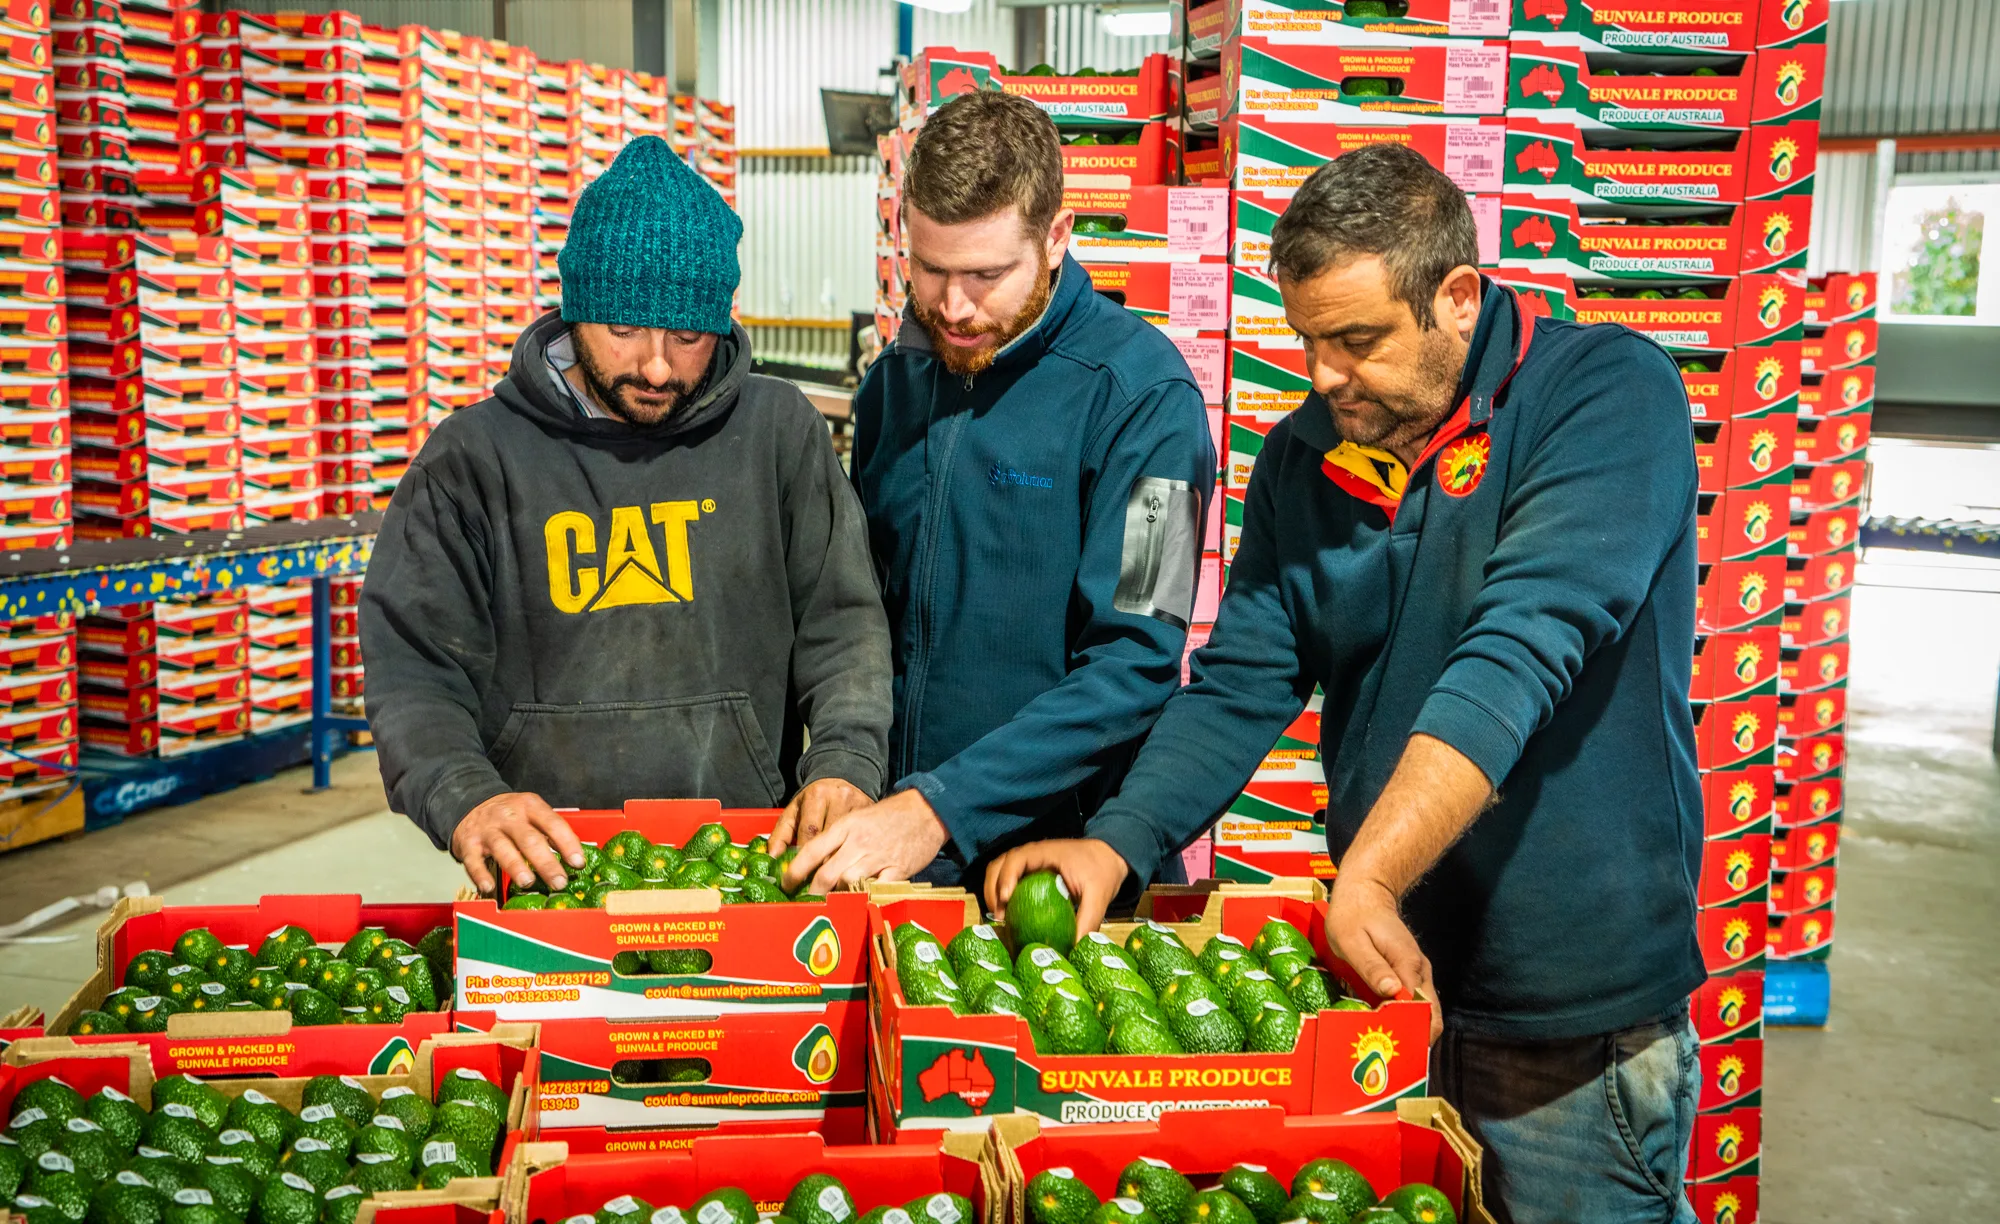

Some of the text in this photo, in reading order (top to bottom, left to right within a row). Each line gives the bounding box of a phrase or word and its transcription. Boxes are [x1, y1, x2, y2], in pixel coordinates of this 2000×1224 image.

[1593, 10, 1743, 24] SUNVALE PRODUCE
[1605, 33, 1727, 45] PRODUCE OF AUSTRALIA
[1340, 56, 1366, 64] GROWN
[1404, 57, 1415, 65] BY:
[1343, 65, 1410, 73] SUNVALE PRODUCE
[1003, 83, 1138, 96] SUNVALE PRODUCE
[1246, 90, 1262, 99] Ph:
[1590, 88, 1737, 101] SUNVALE PRODUCE
[1061, 104, 1072, 113] OF
[1075, 104, 1125, 113] AUSTRALIA
[1246, 102, 1269, 110] Vince
[1602, 110, 1723, 122] PRODUCE OF AUSTRALIA
[1336, 133, 1364, 141] GROWN
[1401, 133, 1413, 142] BY:
[1071, 156, 1137, 168] PRODUCE
[1243, 167, 1259, 176] Ph:
[1584, 163, 1732, 176] SUNVALE PRODUCE
[1243, 178, 1268, 187] Vince
[1597, 185, 1718, 197] PRODUCE OF AUSTRALIA
[1580, 237, 1727, 250] SUNVALE PRODUCE
[1592, 259, 1712, 270] PRODUCE OF AUSTRALIA
[1090, 270, 1131, 278] PACKED BY:
[1576, 310, 1722, 323] SUNVALE PRODUCE
[1654, 332, 1709, 343] AUSTRALIA
[545, 501, 700, 614] CAT
[610, 921, 726, 934] GROWN & PACKED BY:
[616, 932, 719, 945] SUNVALE PRODUCE
[466, 972, 610, 989] Ph: Cossy 0427837129
[466, 989, 580, 1004] Vince 0438263948
[645, 983, 821, 1000] covin@sunvaleproduce.com
[609, 1029, 725, 1042] GROWN & PACKED BY:
[168, 1043, 296, 1059] GROWN & PACKED BY:
[616, 1041, 718, 1054] SUNVALE PRODUCE
[176, 1055, 288, 1070] SUNVALE PRODUCE
[1042, 1068, 1292, 1090] SUNVALE PRODUCE
[644, 1090, 820, 1108] covin@sunvaleproduce.com
[1065, 1103, 1146, 1121] PRODUCE
[606, 1140, 694, 1152] GROWN & PACKE
